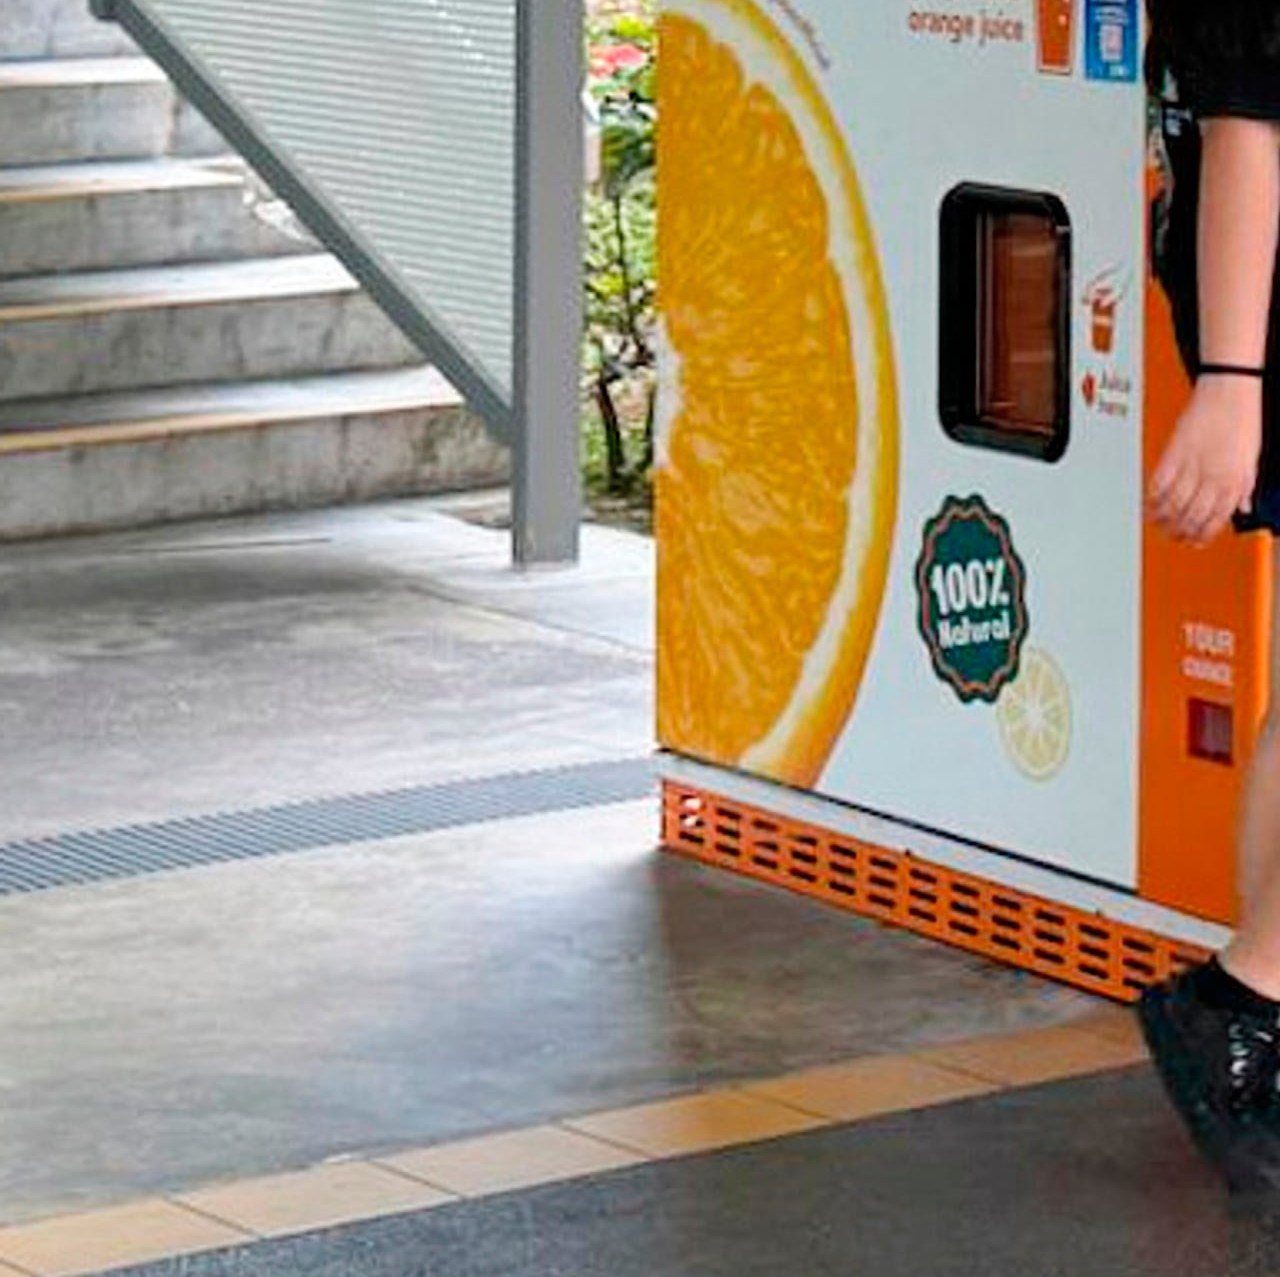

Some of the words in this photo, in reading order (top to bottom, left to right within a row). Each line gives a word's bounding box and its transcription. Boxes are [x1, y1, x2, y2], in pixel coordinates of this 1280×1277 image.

[908, 9, 976, 44] orange
[979, 10, 1023, 44] juice
[931, 559, 1010, 616] 100%
[937, 608, 1011, 649] Natural
